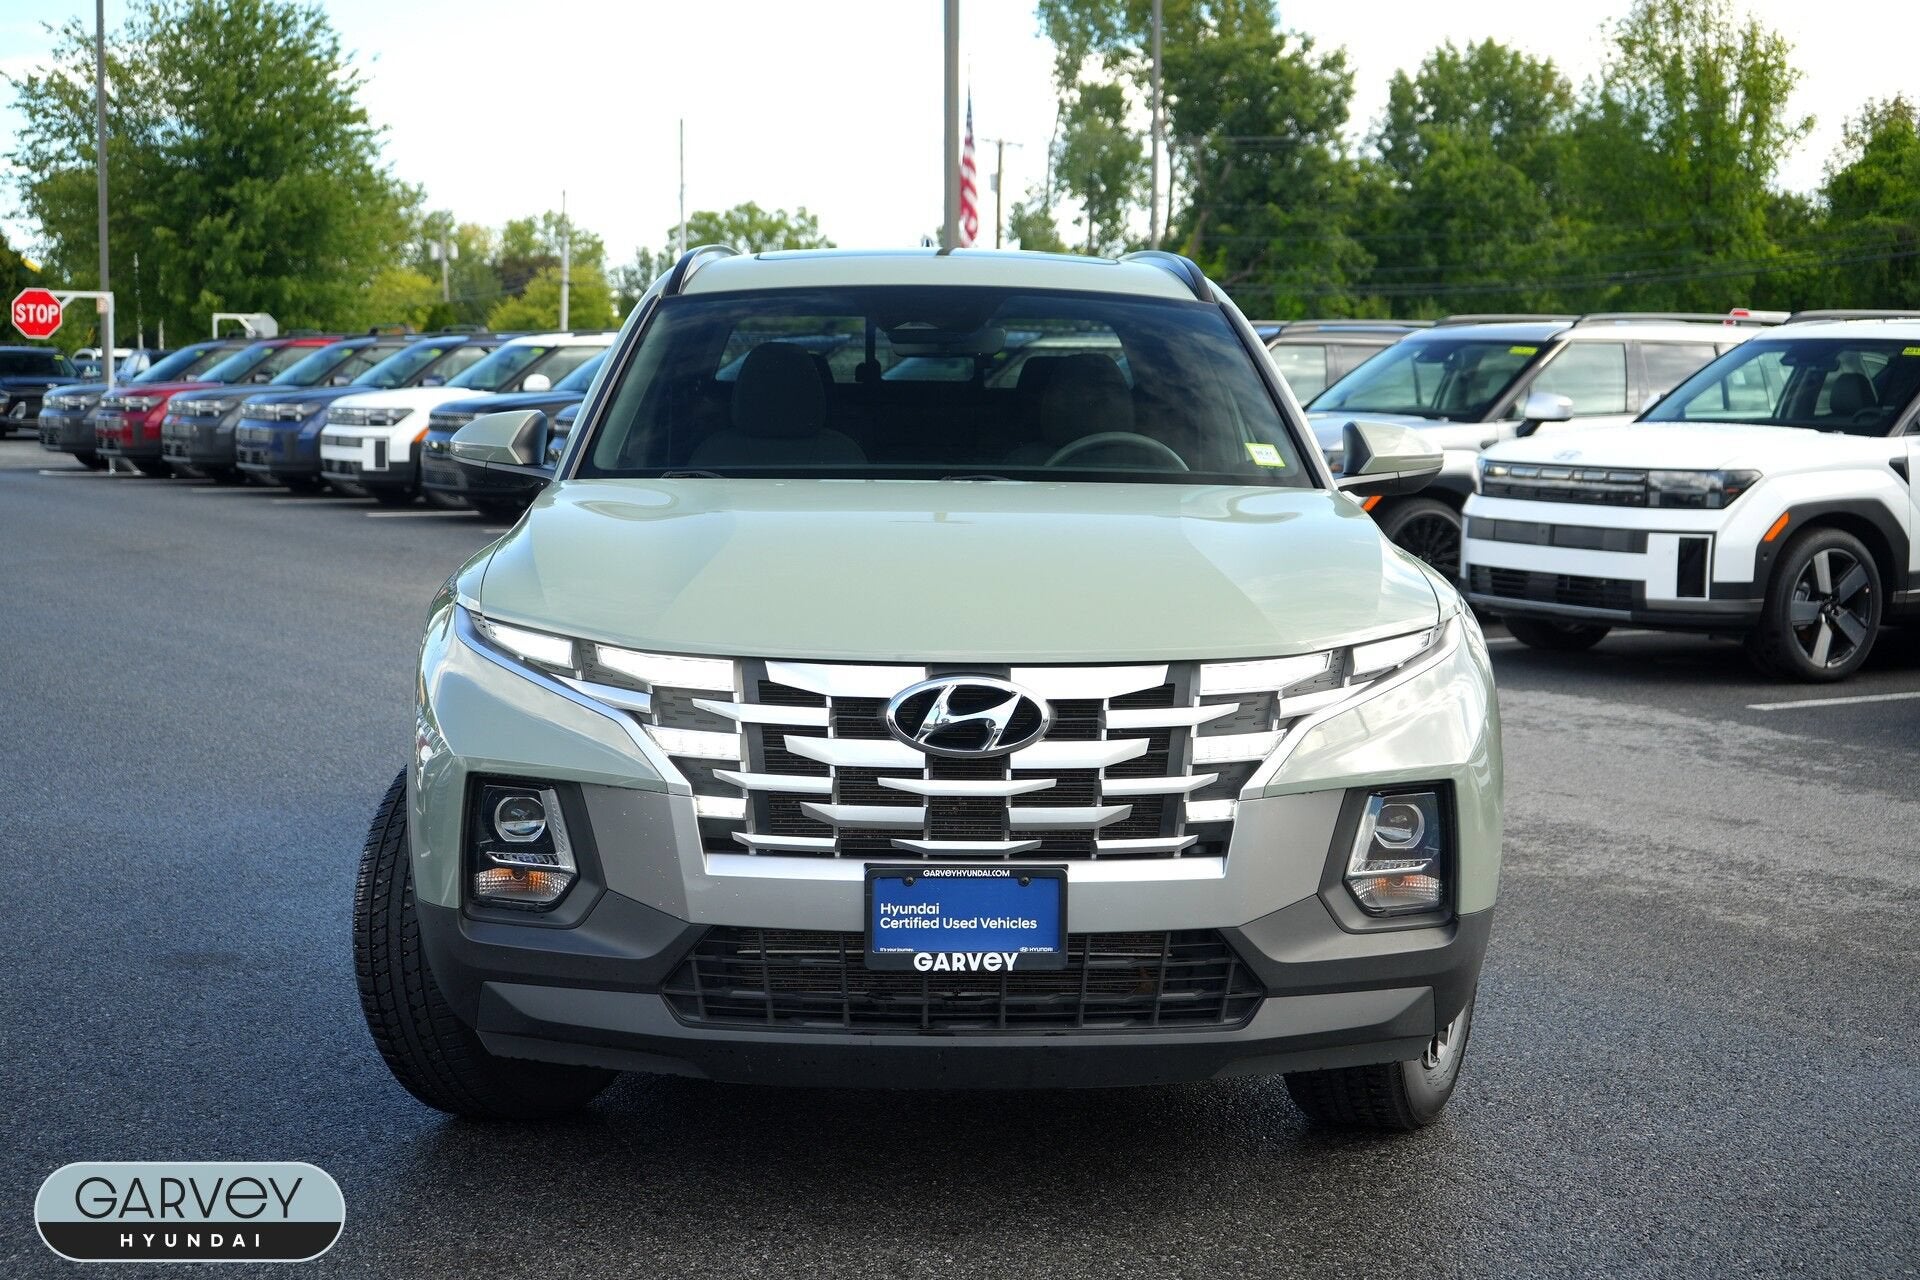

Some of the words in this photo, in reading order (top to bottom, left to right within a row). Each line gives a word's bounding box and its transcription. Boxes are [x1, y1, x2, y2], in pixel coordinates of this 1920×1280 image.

[15, 303, 59, 324] STOP
[880, 902, 940, 916] Hyundai
[880, 917, 940, 929] Certified
[943, 917, 978, 929] Used
[980, 917, 1038, 929] Vehicles
